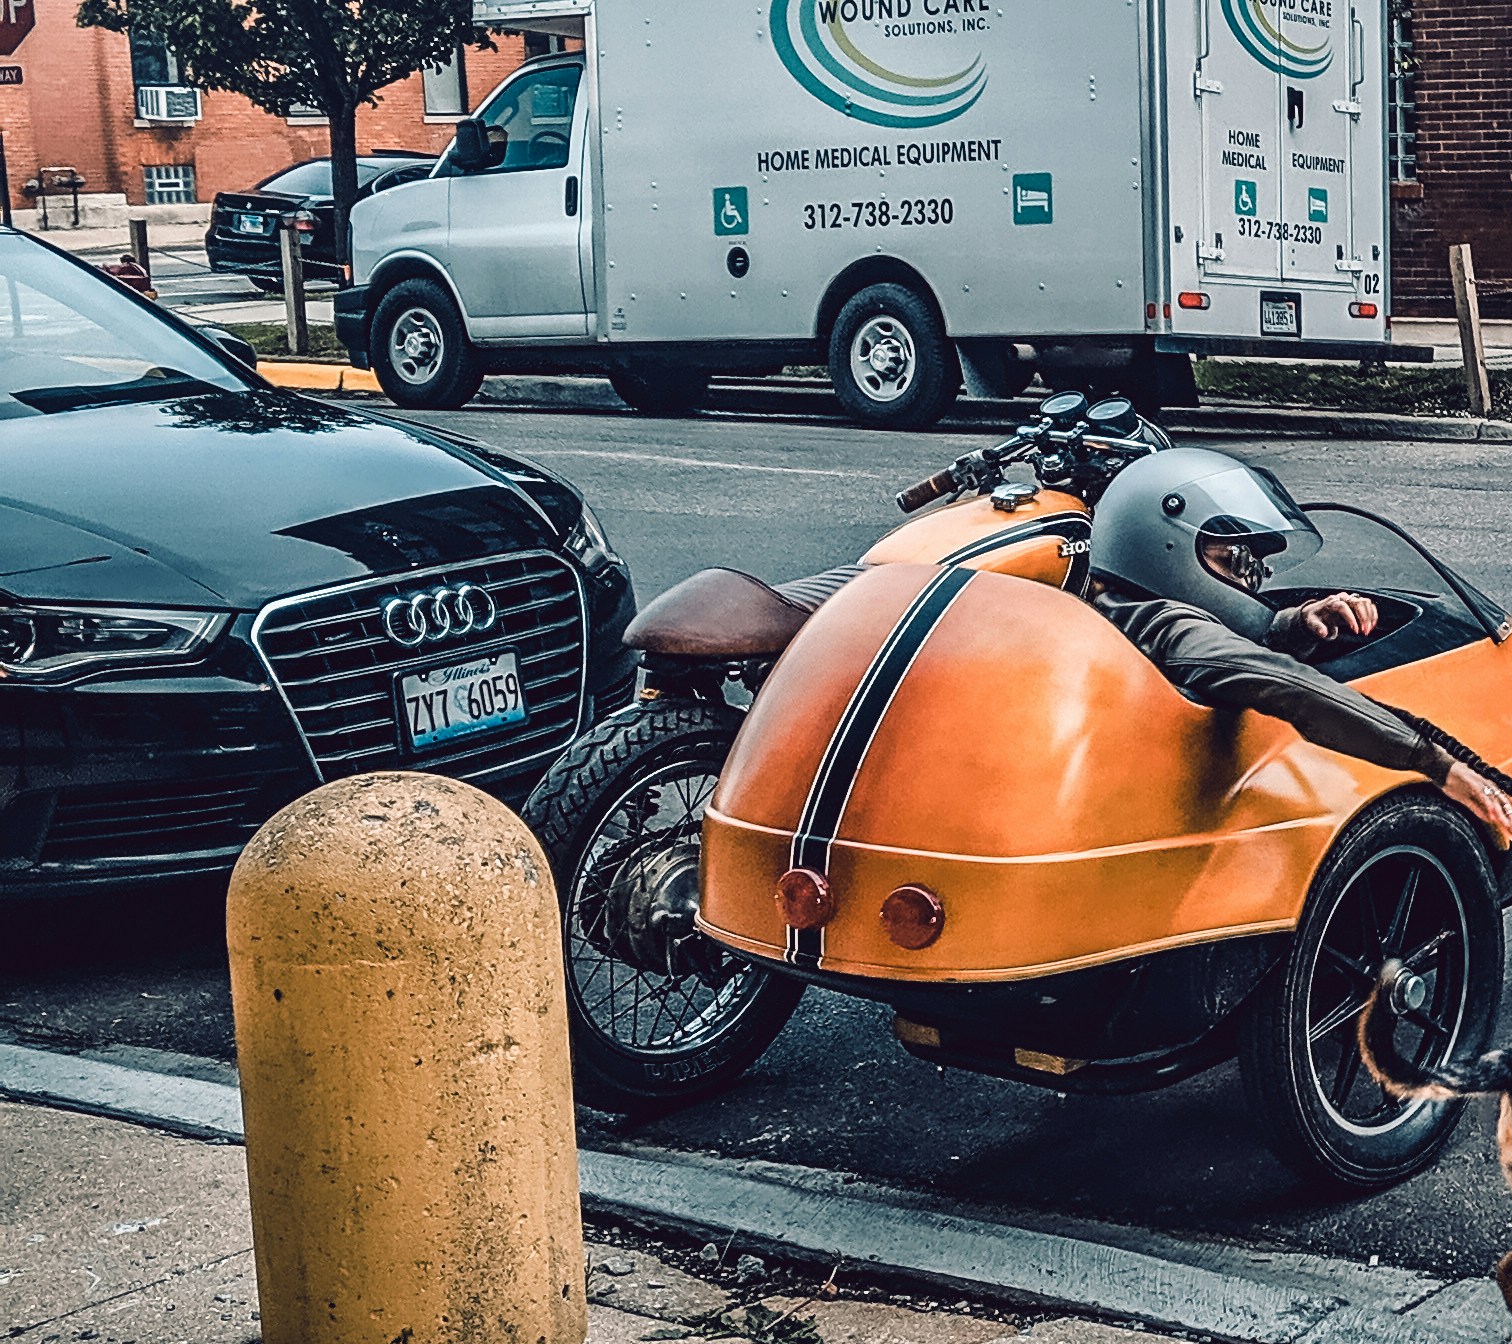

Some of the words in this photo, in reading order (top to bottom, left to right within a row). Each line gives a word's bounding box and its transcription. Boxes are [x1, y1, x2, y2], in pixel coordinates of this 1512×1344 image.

[884, 20, 957, 38] SOLUTIONS,
[962, 16, 991, 32] INC.
[1228, 129, 1260, 149] HOME
[757, 151, 810, 172] HOME
[815, 145, 892, 170] MEDICAL
[897, 139, 1002, 165] EQUIPMENT
[1222, 150, 1267, 170] MEDICAL
[1292, 152, 1345, 174] EQUIPMENT
[803, 199, 954, 230] 312-738-2330
[1238, 217, 1322, 245] 312-738-2330
[1364, 273, 1380, 295] 02
[442, 662, 491, 683] Illinois
[406, 689, 451, 736] ZY7
[467, 673, 519, 720] 6059
